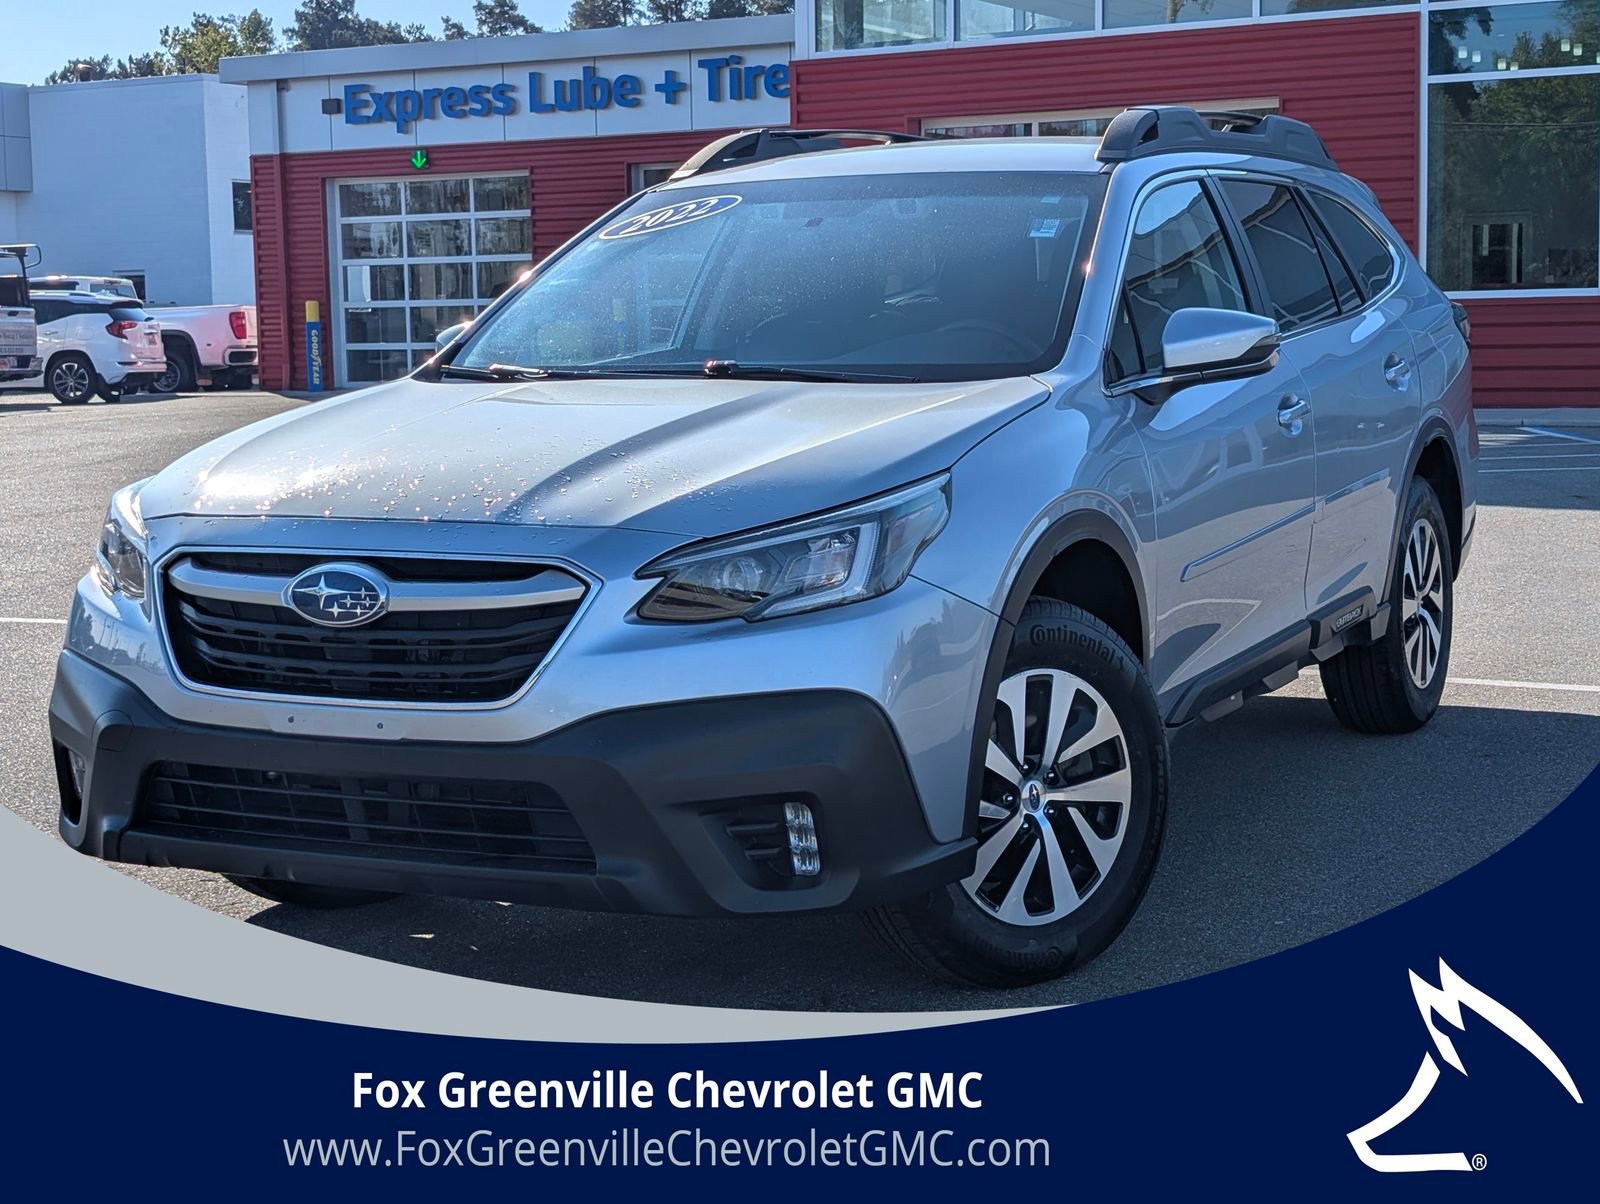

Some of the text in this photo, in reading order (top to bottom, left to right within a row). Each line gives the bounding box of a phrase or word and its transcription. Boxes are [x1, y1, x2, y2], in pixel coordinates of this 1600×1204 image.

[344, 83, 519, 134] Express
[529, 66, 642, 113] Lube
[698, 55, 789, 102] Tire
[618, 199, 720, 235] 2022
[311, 329, 322, 385] GOODYEAR
[1029, 624, 1118, 665] Continental
